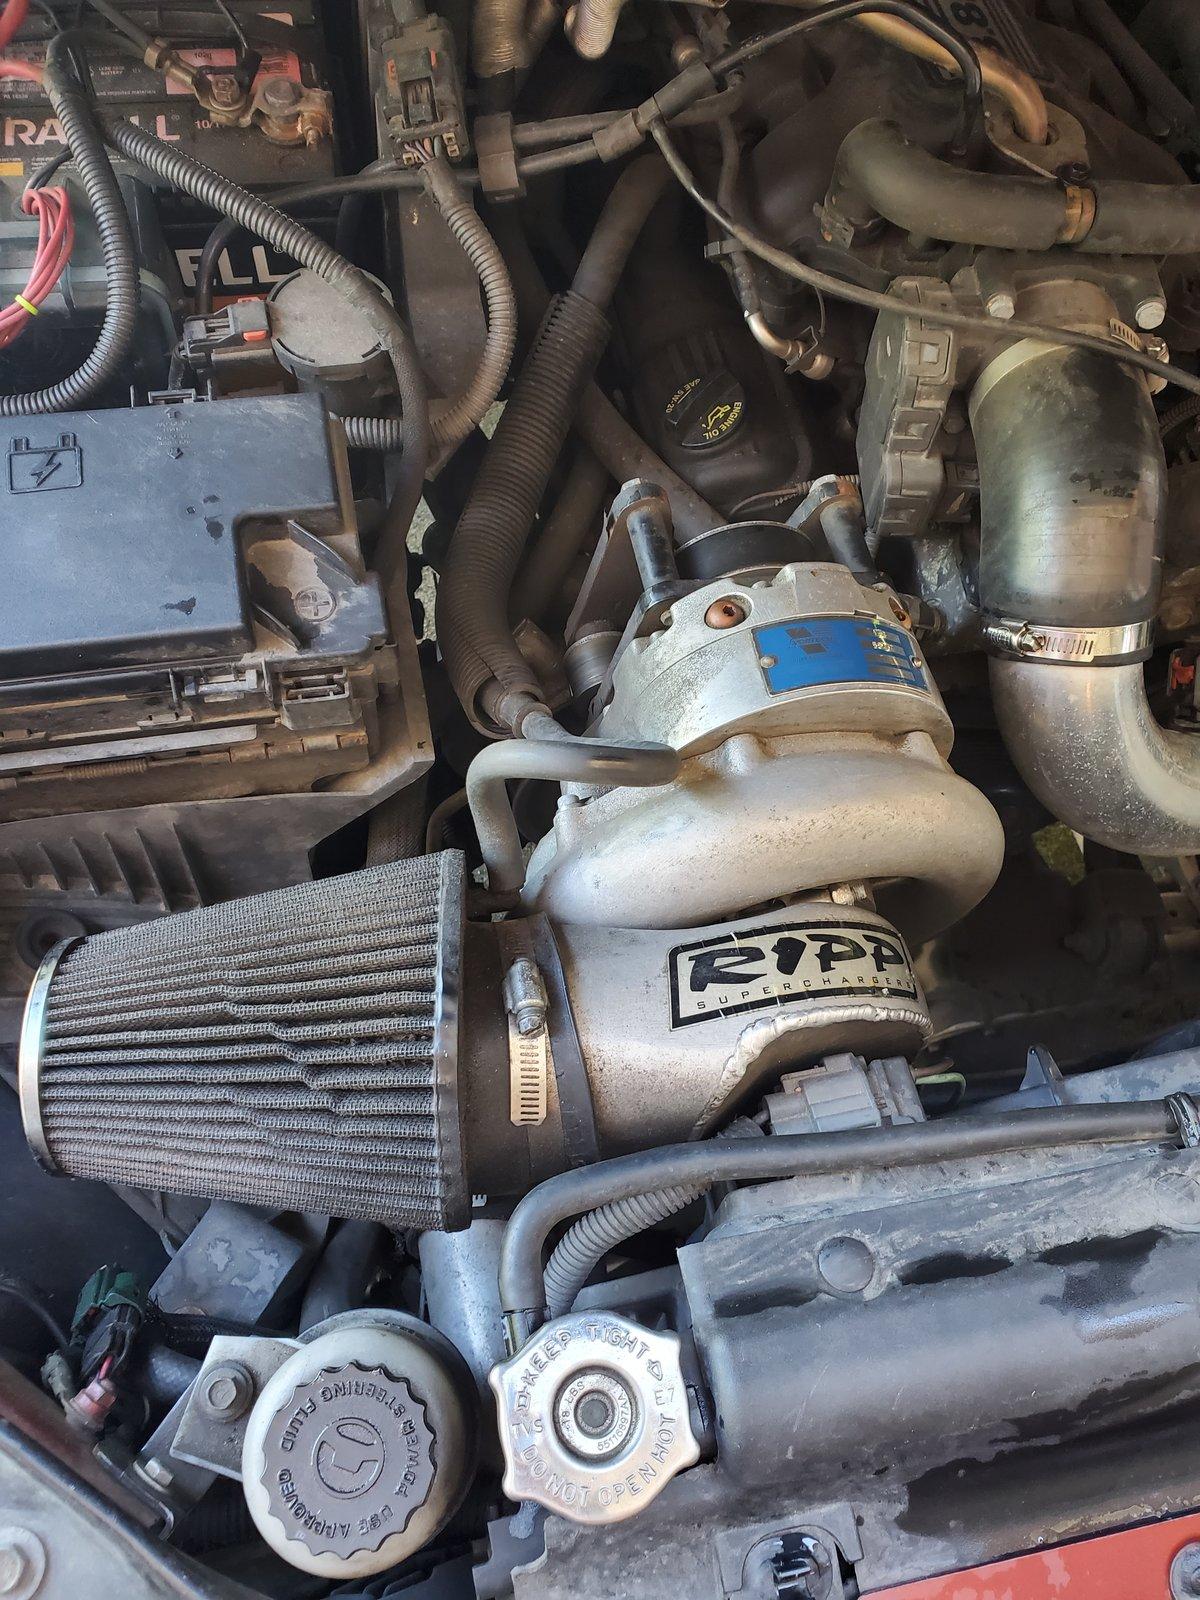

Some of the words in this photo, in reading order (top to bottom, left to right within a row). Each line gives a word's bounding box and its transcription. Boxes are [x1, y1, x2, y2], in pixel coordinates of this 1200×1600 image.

[665, 389, 685, 414] 5W-20
[718, 401, 743, 432] ENGINE
[702, 428, 720, 440] OIL
[688, 933, 905, 992] RIPP
[520, 1329, 573, 1386] KEEP
[585, 1322, 651, 1359] TIGHT
[321, 1380, 406, 1419] STEERING
[567, 1380, 586, 1405] LBS
[280, 1398, 317, 1452] FLUID
[394, 1418, 420, 1498] POWER
[522, 1443, 548, 1479] DO
[545, 1472, 593, 1507] NOT
[597, 1462, 658, 1506] OPEN
[650, 1413, 676, 1464] HOT
[277, 1468, 351, 1540] APPROVED
[358, 1504, 394, 1535] USE
